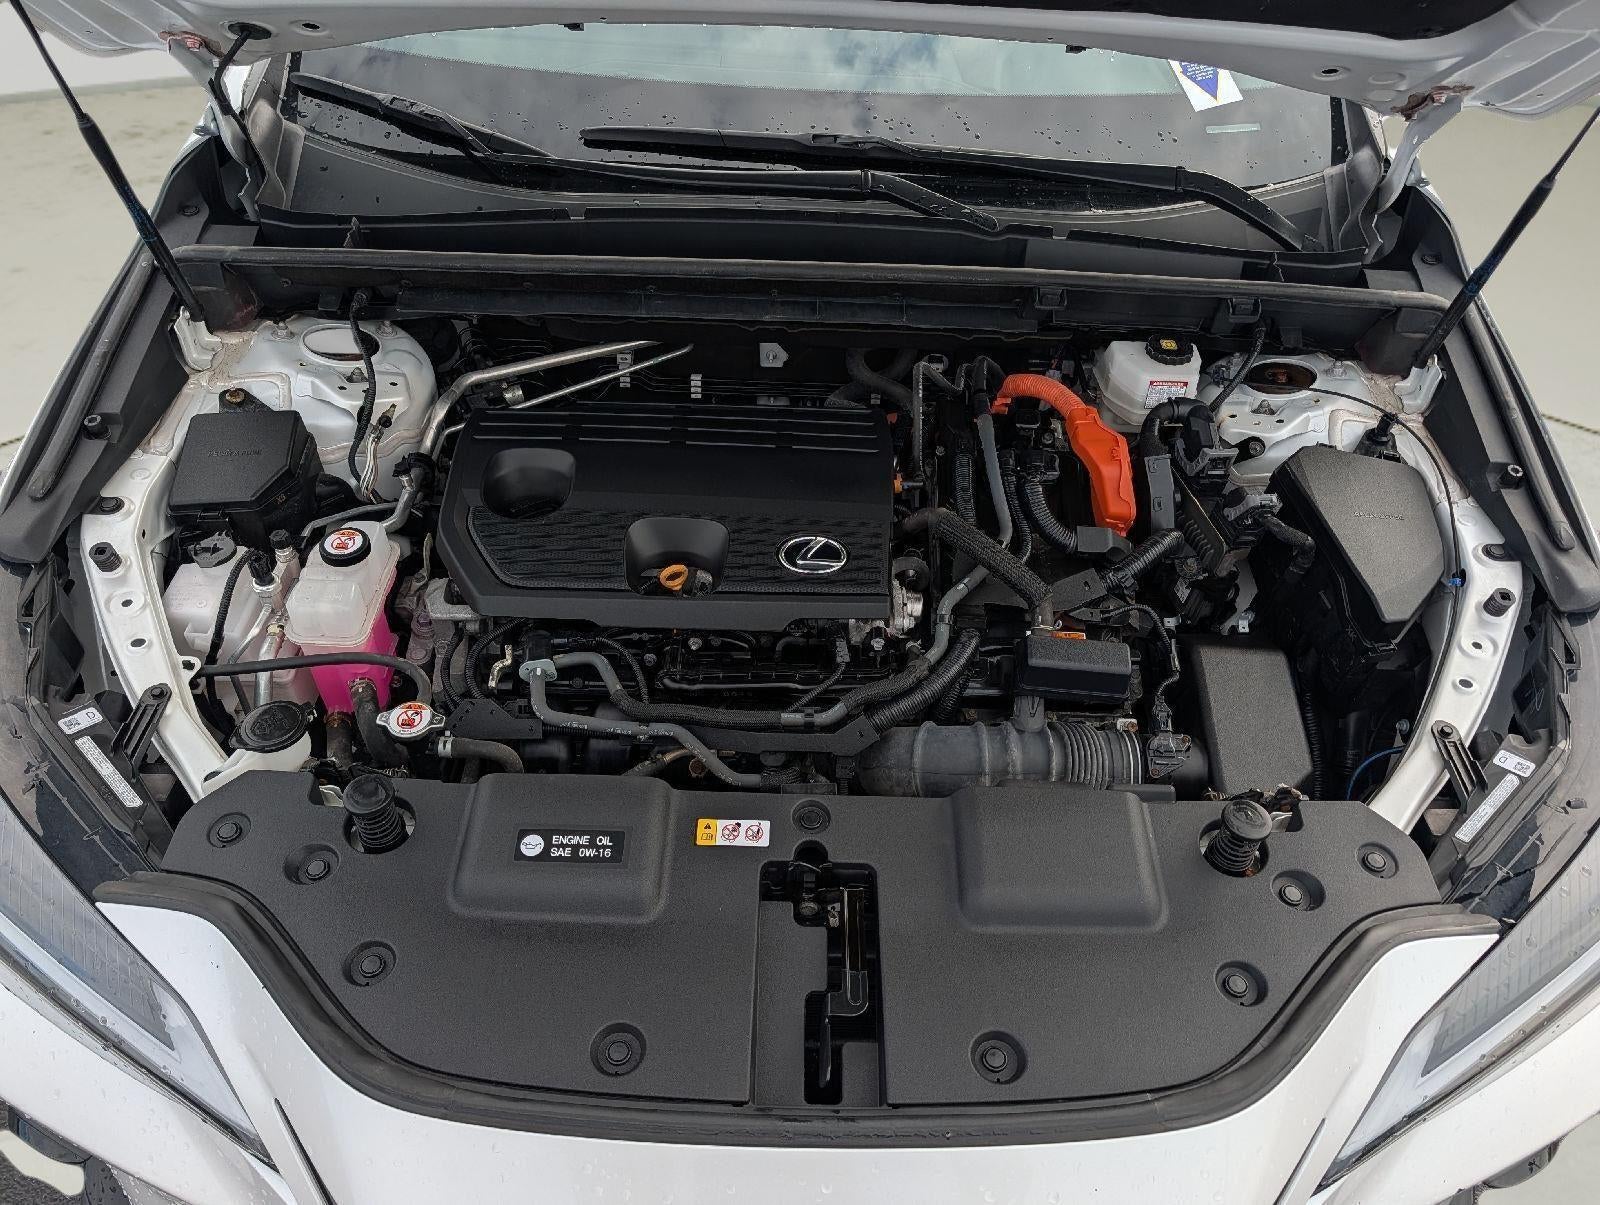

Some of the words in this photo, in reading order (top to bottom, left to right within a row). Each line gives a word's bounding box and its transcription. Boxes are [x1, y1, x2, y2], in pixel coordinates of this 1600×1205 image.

[552, 835, 590, 845] ENGINE
[596, 836, 613, 846] OIL
[550, 848, 571, 857] SAE
[579, 848, 611, 858] 0W-16
